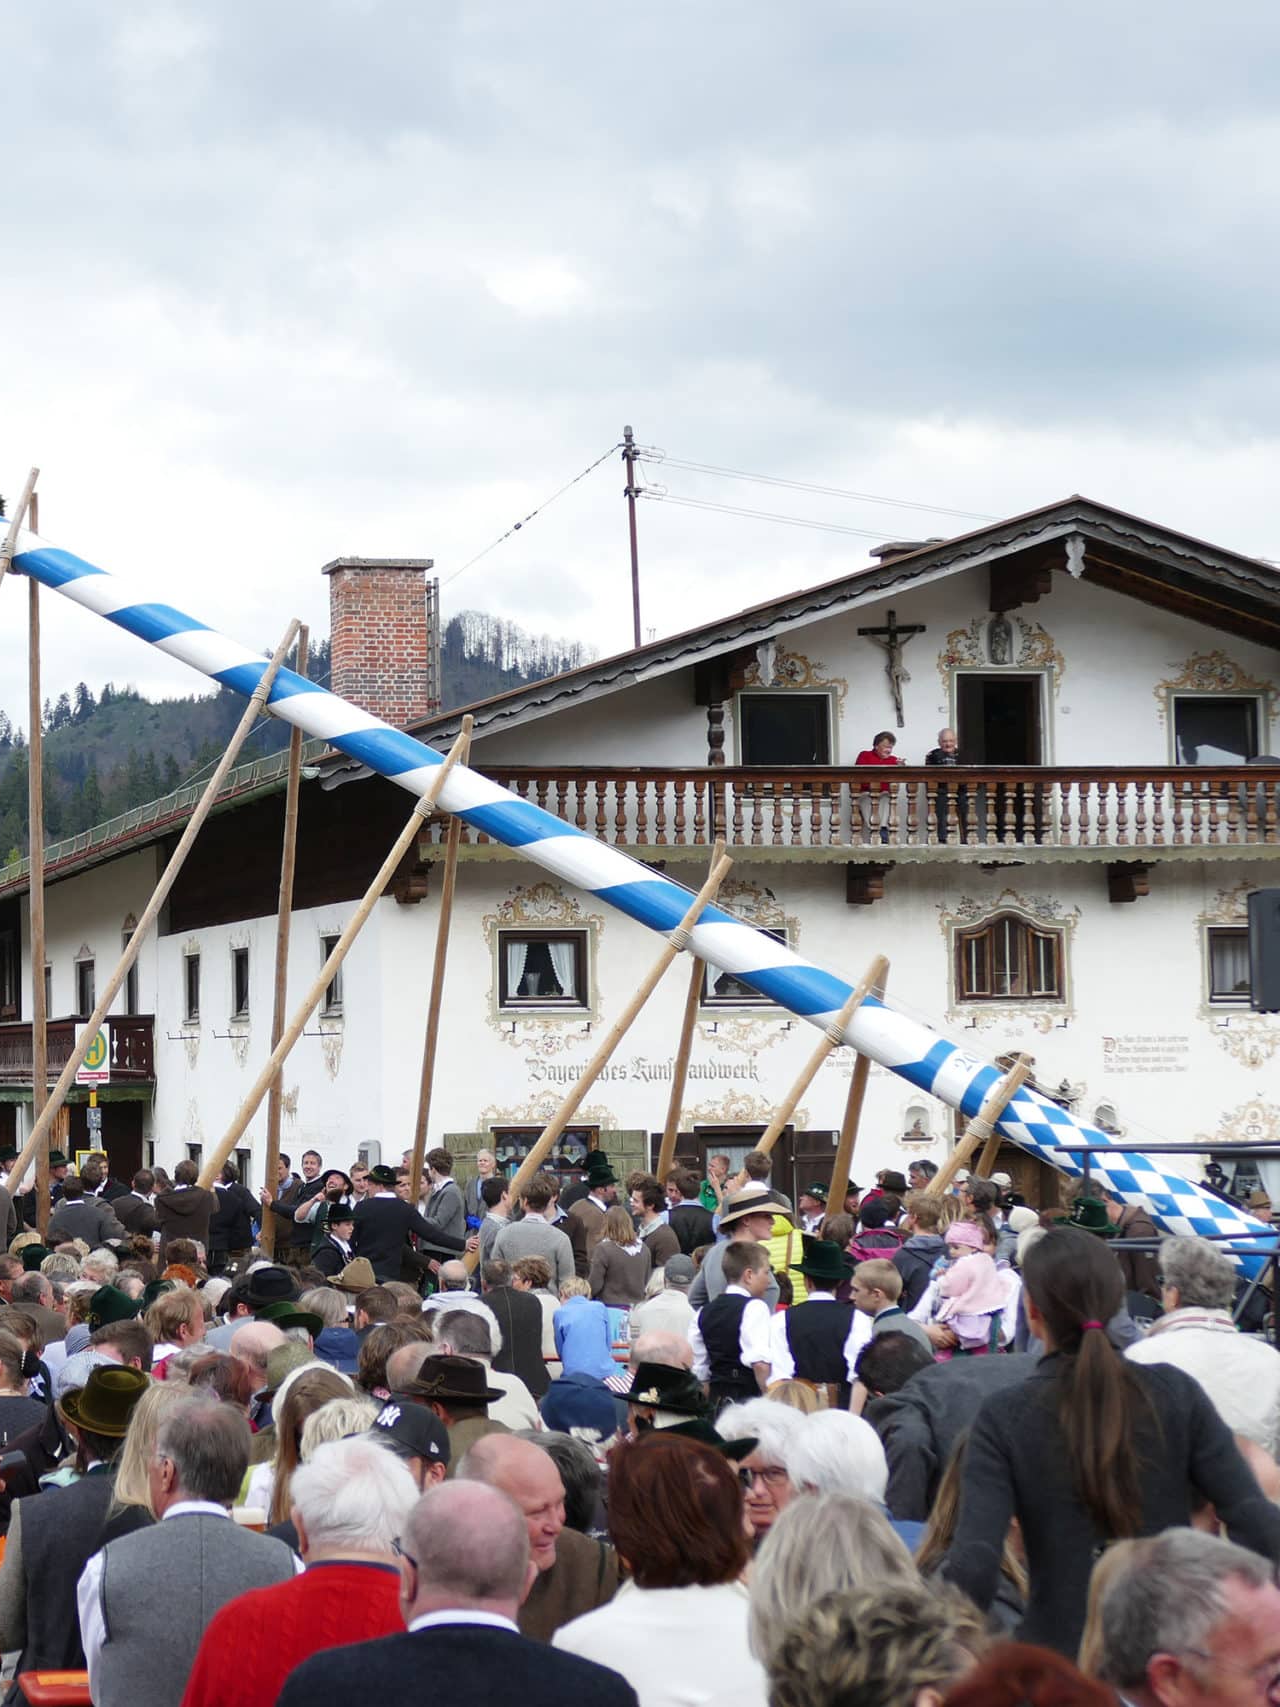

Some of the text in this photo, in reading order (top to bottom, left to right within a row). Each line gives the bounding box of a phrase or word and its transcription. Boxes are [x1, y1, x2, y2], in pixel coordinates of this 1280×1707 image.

[525, 1056, 760, 1085] Bayerihes Kunsandwerk
[376, 1405, 401, 1427] NY
